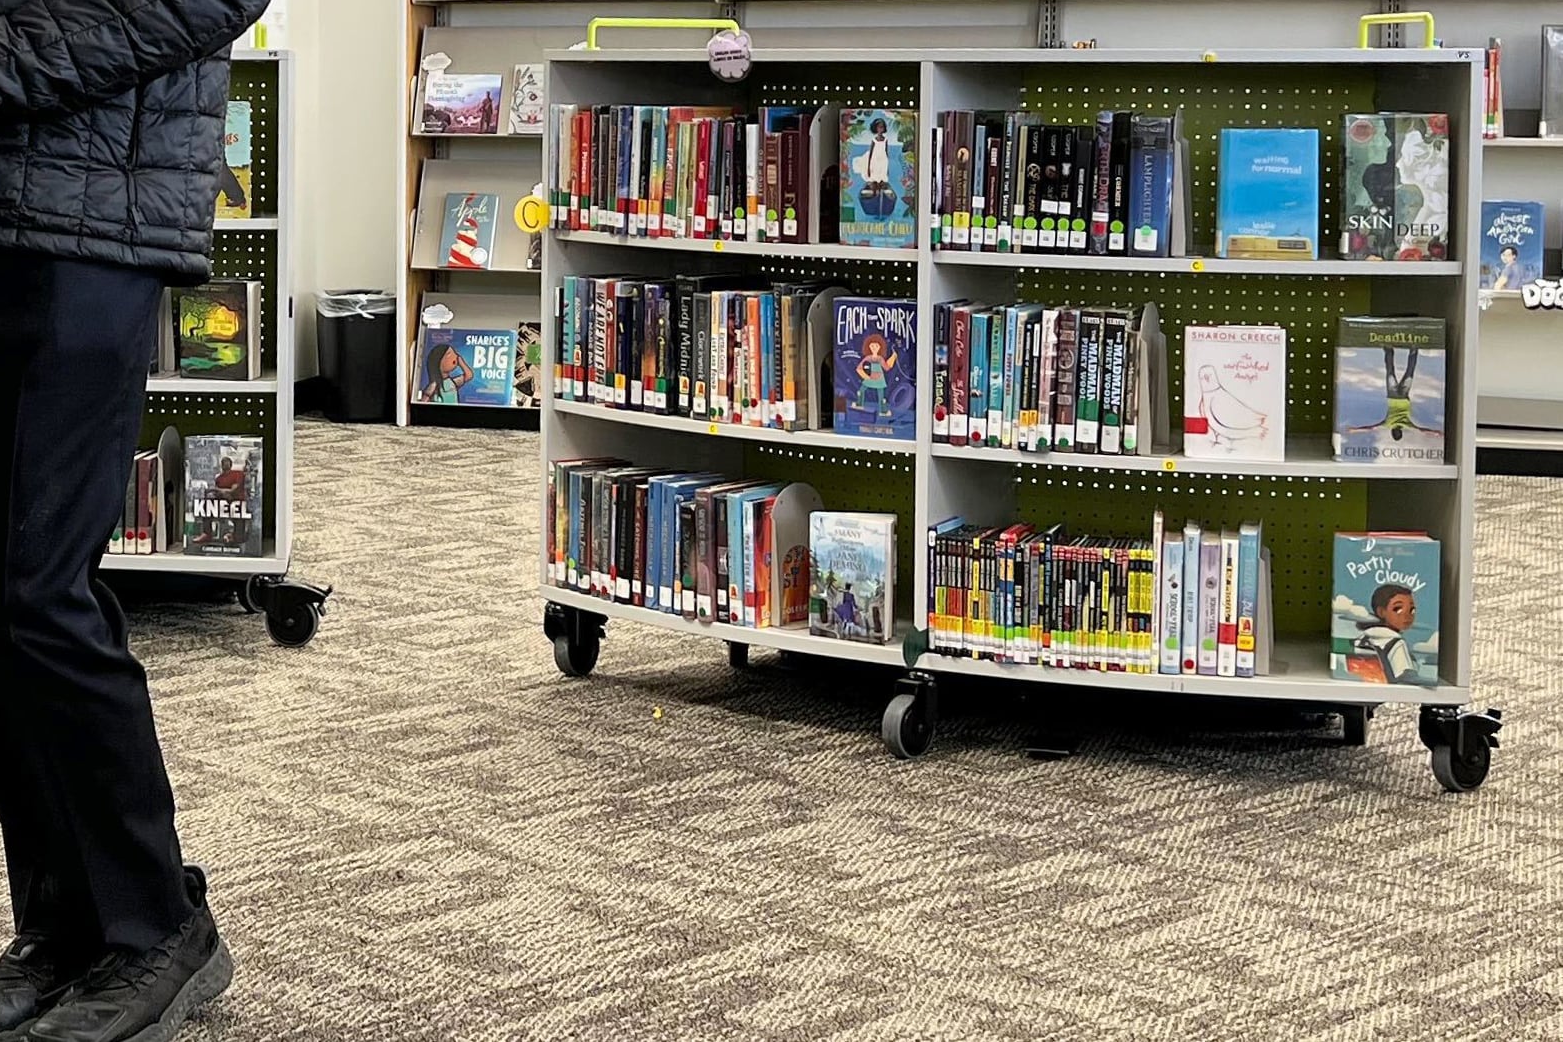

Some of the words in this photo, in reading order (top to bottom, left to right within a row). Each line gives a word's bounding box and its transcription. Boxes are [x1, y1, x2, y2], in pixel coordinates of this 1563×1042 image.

[451, 196, 488, 227] Apple
[522, 200, 540, 229] C
[1348, 215, 1393, 230] SKIN
[1397, 223, 1440, 237] DEEP
[679, 295, 691, 328] Lady
[837, 305, 867, 345] EACH
[877, 306, 916, 350] SPARK
[1191, 331, 1236, 341] SHARON
[1240, 333, 1281, 342] CREECH
[1369, 332, 1430, 344] Deadline
[465, 335, 510, 346] SHARICE'S
[473, 346, 508, 369] BIG
[678, 332, 692, 378] Midnig
[1080, 337, 1089, 369] PINEY
[1105, 338, 1114, 370] PINEY
[480, 369, 507, 380] VOICE
[1110, 343, 1123, 406] MADMAN
[1103, 370, 1112, 410] WOODS
[1344, 446, 1380, 458] CHRIS
[1382, 447, 1444, 459] CRUTCHER
[194, 499, 252, 519] KNEEL
[1346, 555, 1394, 579] Partly
[1375, 569, 1427, 593] Cloudy
